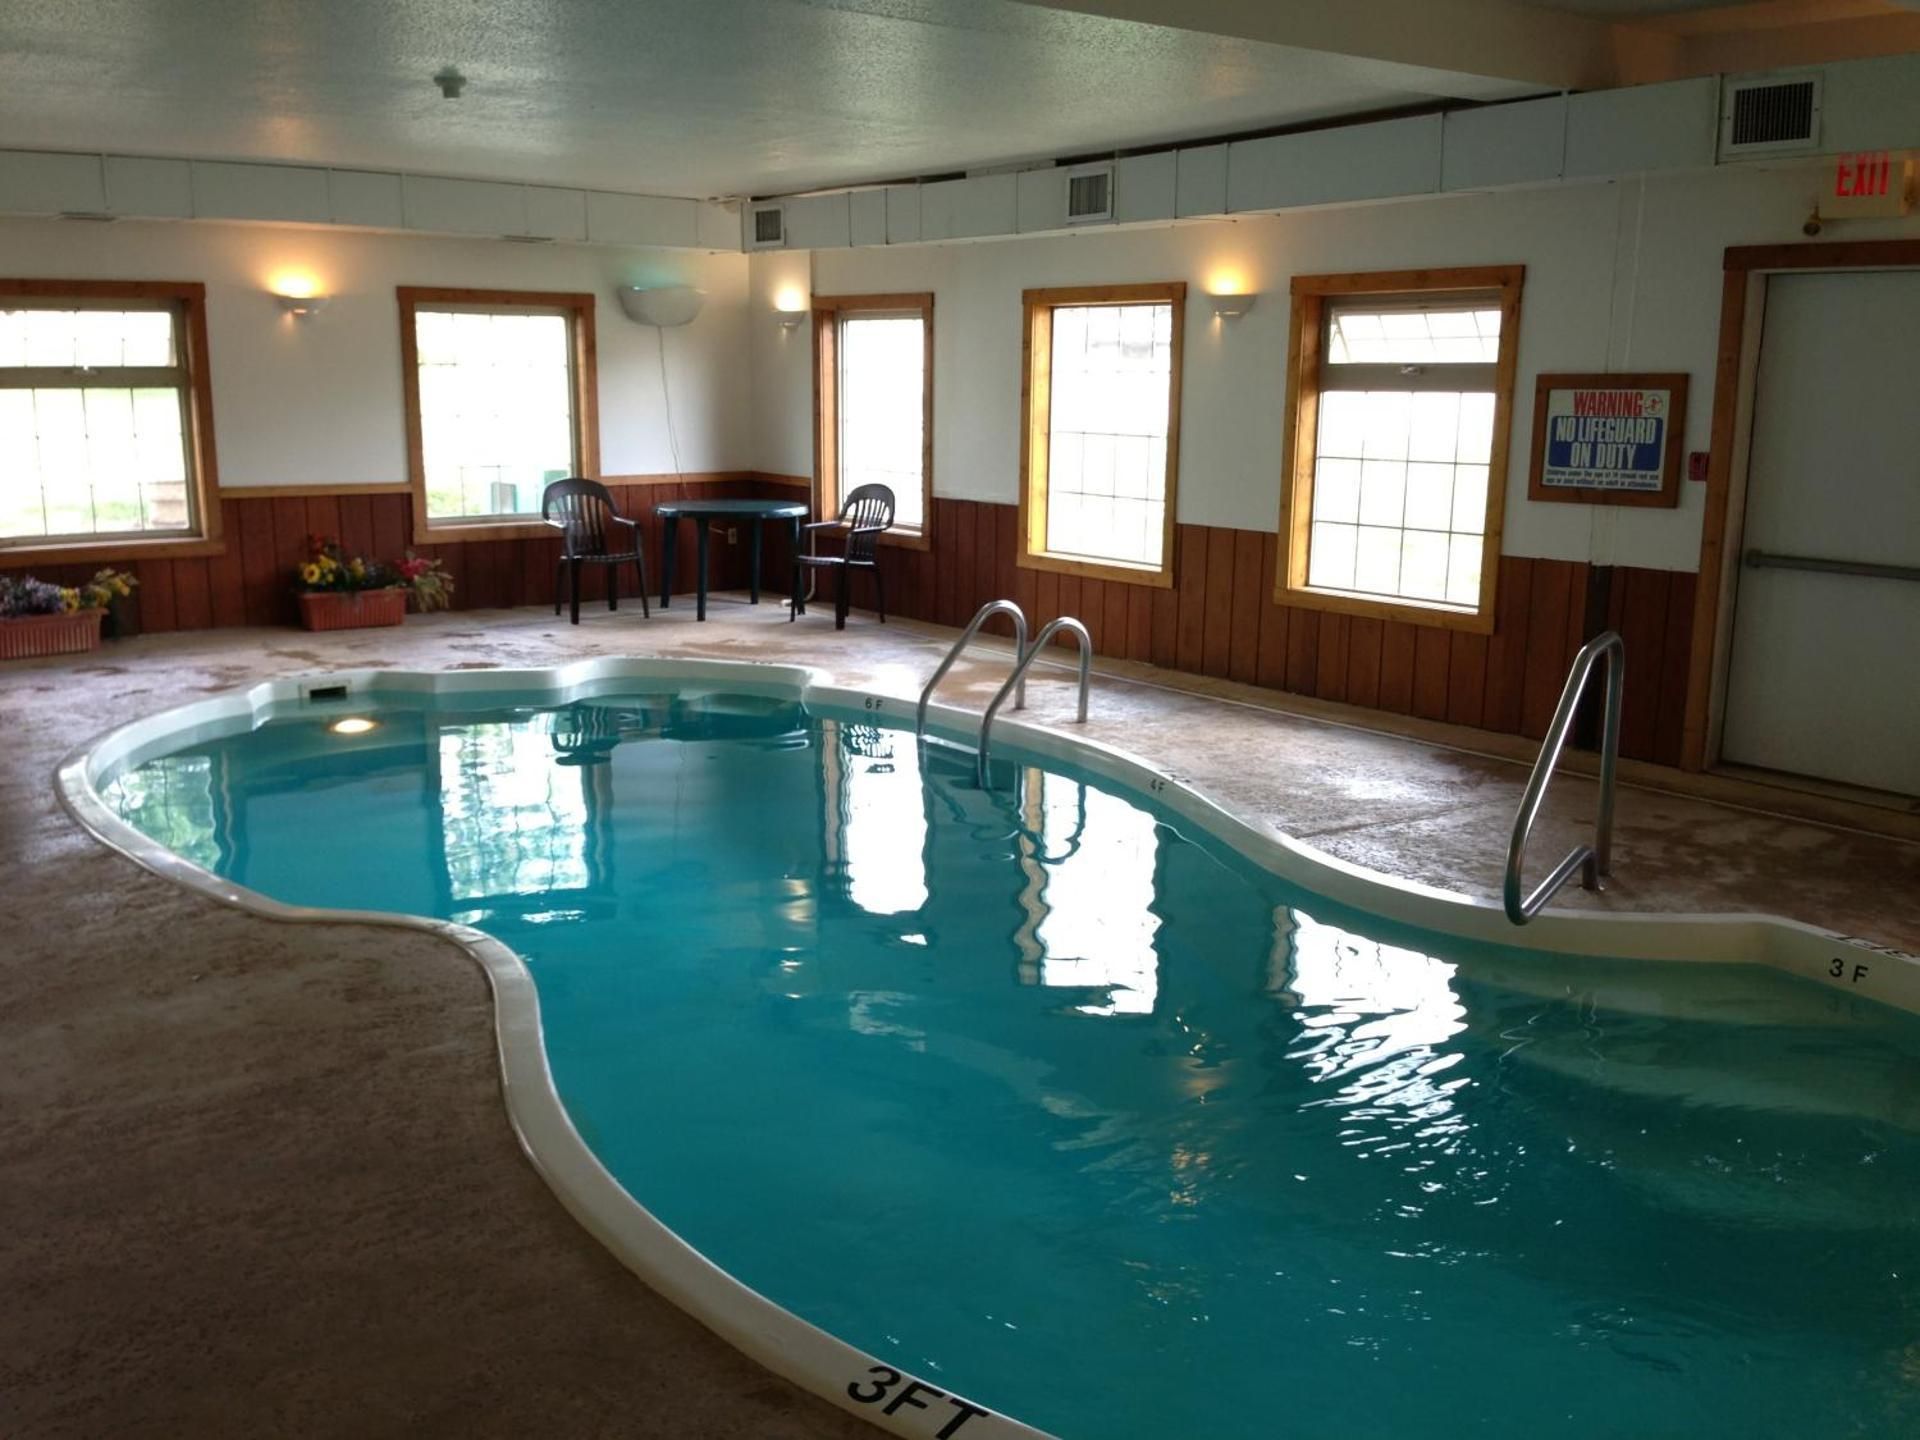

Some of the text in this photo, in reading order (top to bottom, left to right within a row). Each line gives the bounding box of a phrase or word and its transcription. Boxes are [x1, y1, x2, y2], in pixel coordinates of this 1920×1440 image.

[1835, 151, 1888, 197] EXIT
[1573, 391, 1644, 416] WARNING
[1556, 417, 1657, 444] NO LIFEGUARD
[1570, 442, 1637, 469] ON DUTY
[847, 1366, 989, 1440] 3FT
